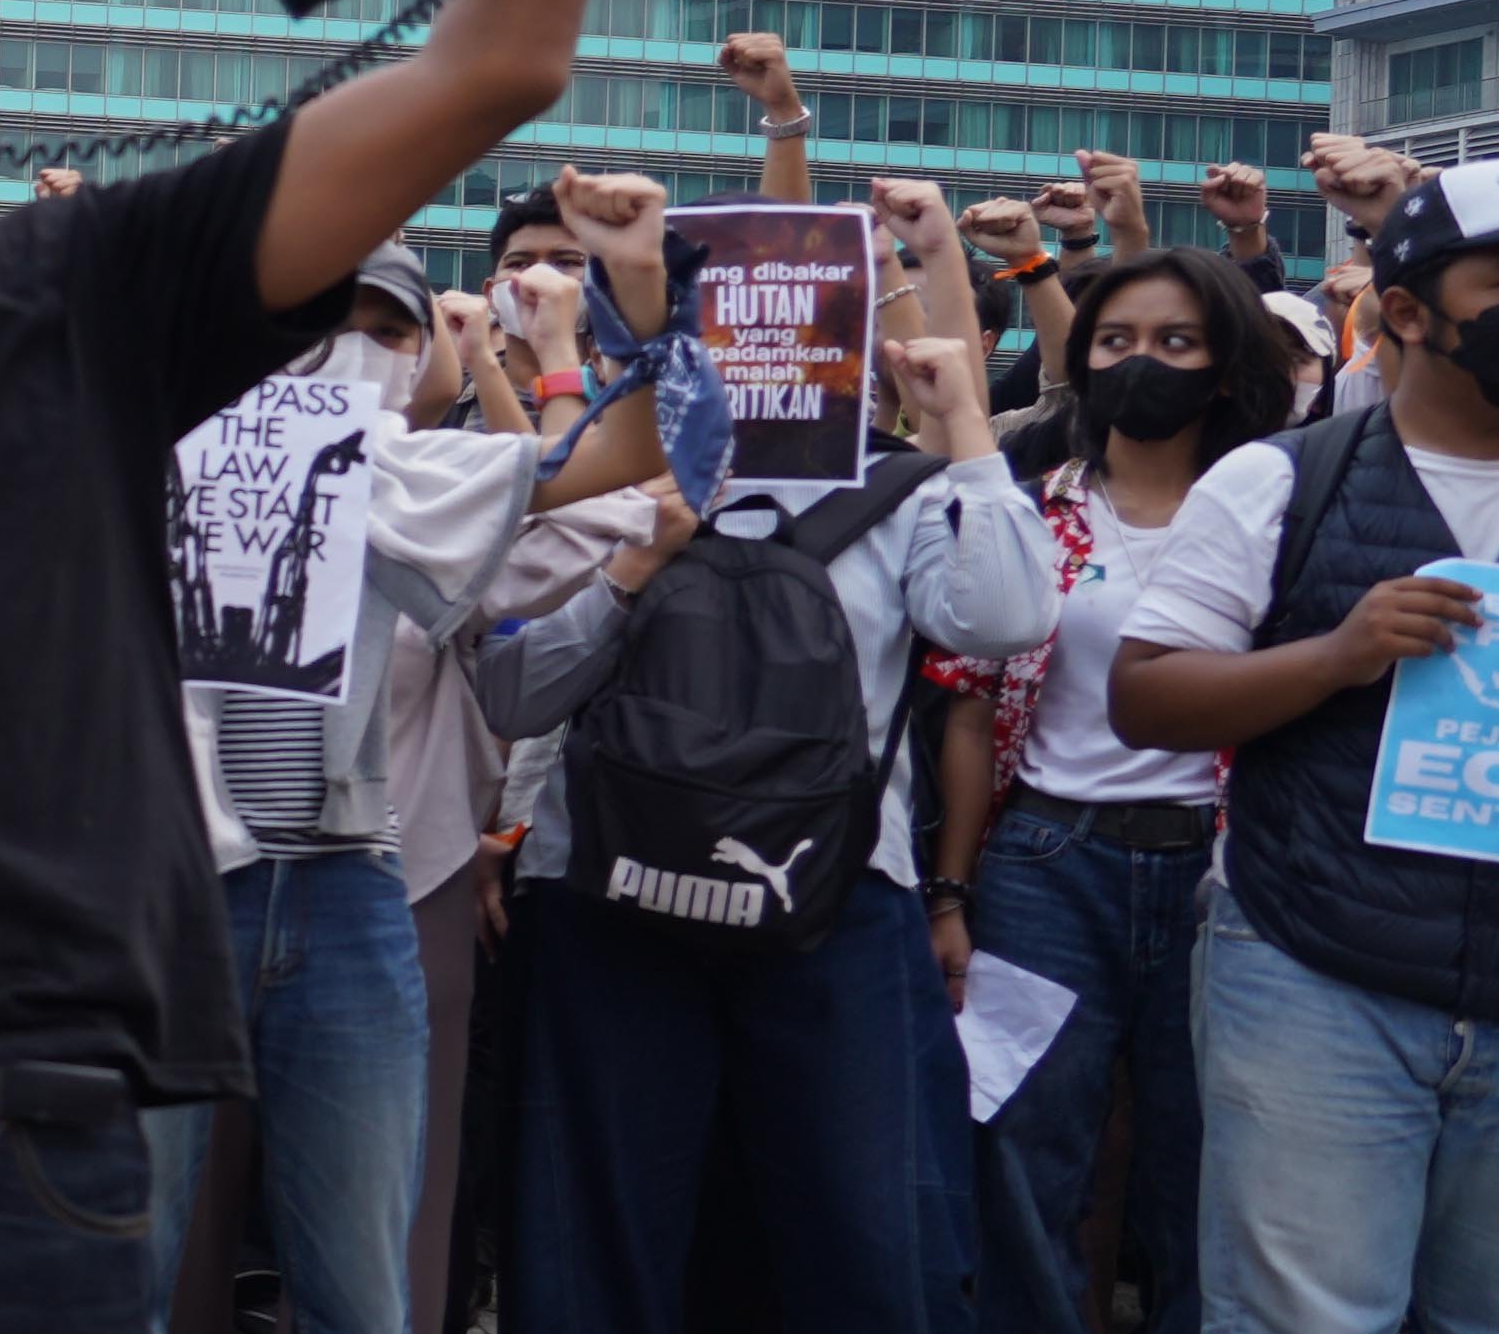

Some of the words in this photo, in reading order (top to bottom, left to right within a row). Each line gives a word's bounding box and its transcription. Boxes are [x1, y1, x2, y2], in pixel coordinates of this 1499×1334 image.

[753, 261, 855, 283] dibakar
[716, 284, 815, 326] HUTAN
[732, 327, 797, 347] yang
[724, 363, 805, 381] malah
[257, 380, 350, 416] PASS
[216, 413, 287, 449] THE
[199, 449, 290, 484] LAW
[606, 855, 766, 928] PUMA
